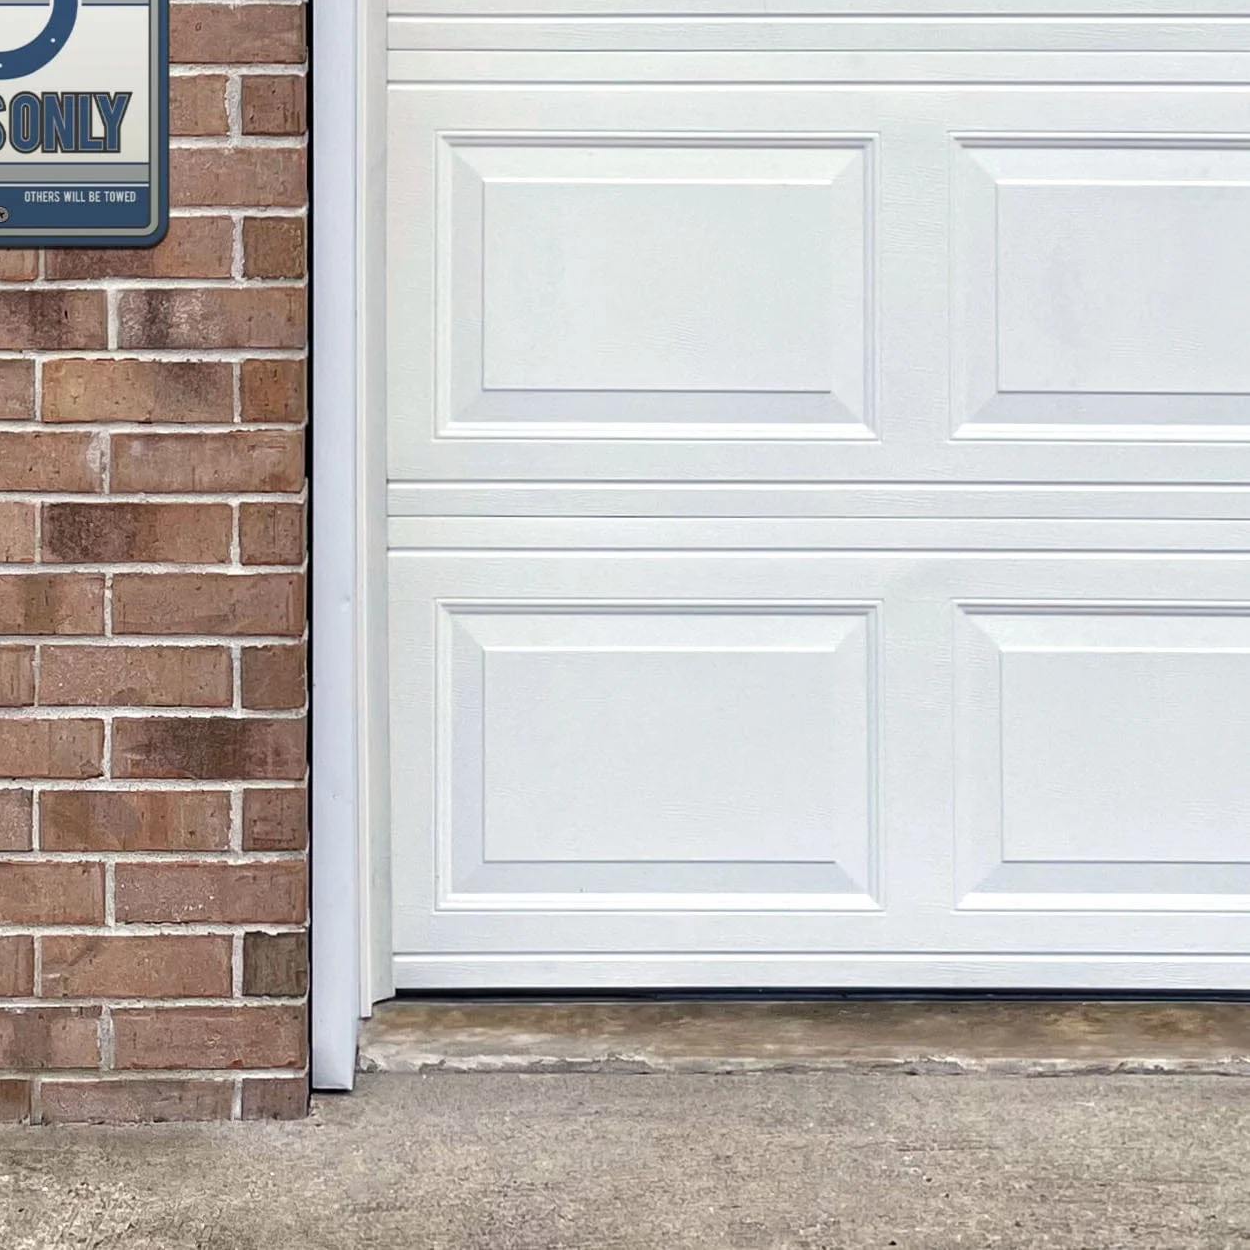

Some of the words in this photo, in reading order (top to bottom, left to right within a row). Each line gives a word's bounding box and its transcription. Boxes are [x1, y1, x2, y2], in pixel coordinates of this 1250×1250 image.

[8, 90, 133, 154] ONLY
[24, 190, 60, 203] OTHERS
[63, 190, 86, 203] WILL
[88, 190, 101, 203] BE
[104, 190, 137, 203] TOWED
